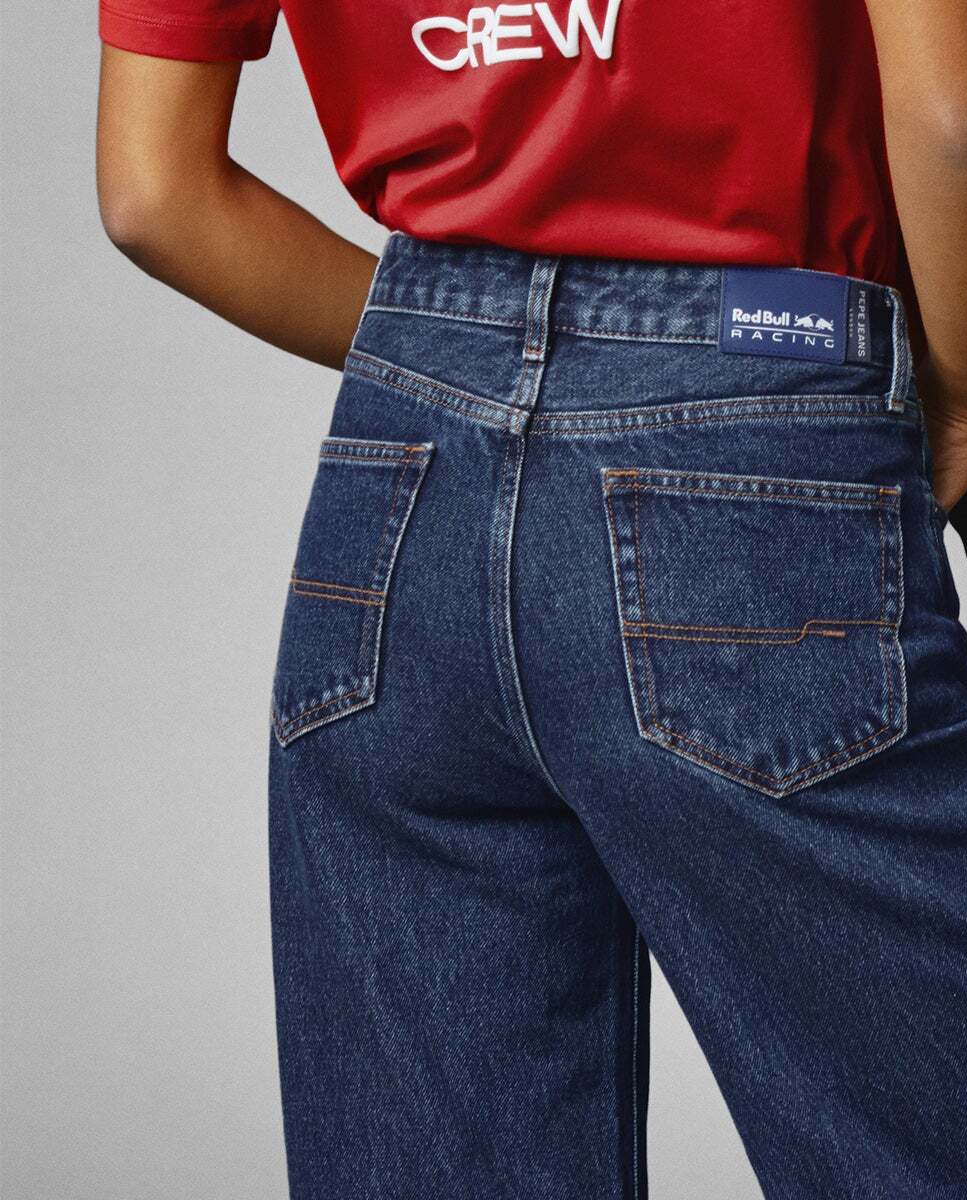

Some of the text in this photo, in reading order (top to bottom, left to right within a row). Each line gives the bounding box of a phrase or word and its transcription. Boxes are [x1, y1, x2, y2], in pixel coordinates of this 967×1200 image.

[731, 308, 790, 327] Red Bull
[857, 290, 866, 358] PEPE JEANS
[730, 328, 835, 349] RACING
